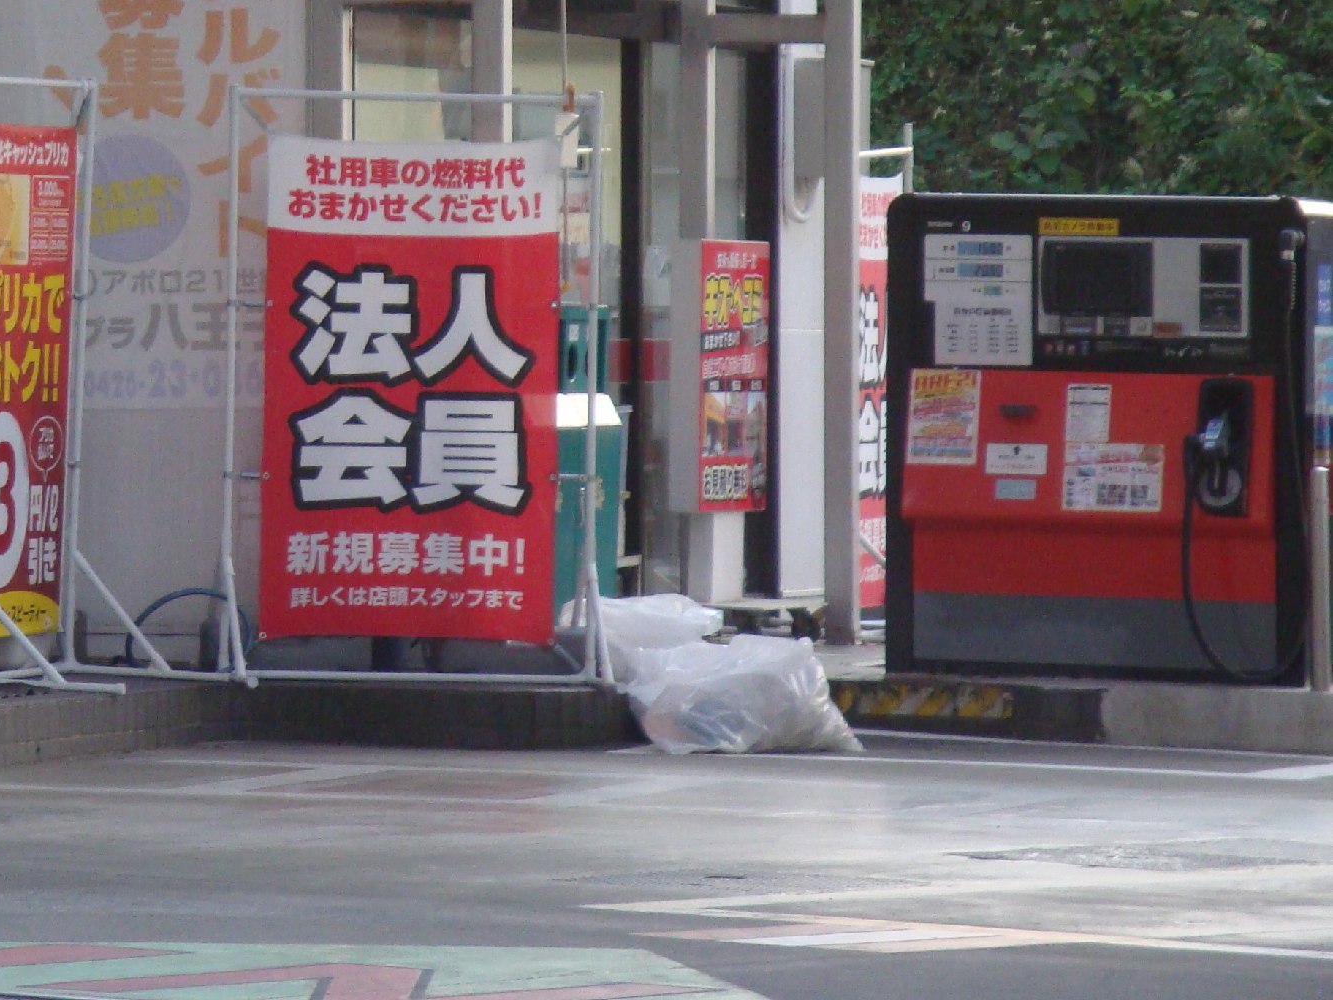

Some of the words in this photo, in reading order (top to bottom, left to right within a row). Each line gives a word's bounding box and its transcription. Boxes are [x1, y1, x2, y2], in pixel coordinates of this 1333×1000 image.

[305, 153, 526, 190] 社用車の燃料代
[287, 188, 543, 225] おまかせください!
[295, 265, 533, 384] 法人
[292, 390, 529, 512] 会員
[28, 536, 57, 585] 引き
[286, 532, 527, 576] 新規募集中!
[289, 585, 524, 610] 詳しくは店頭スタッフまで
